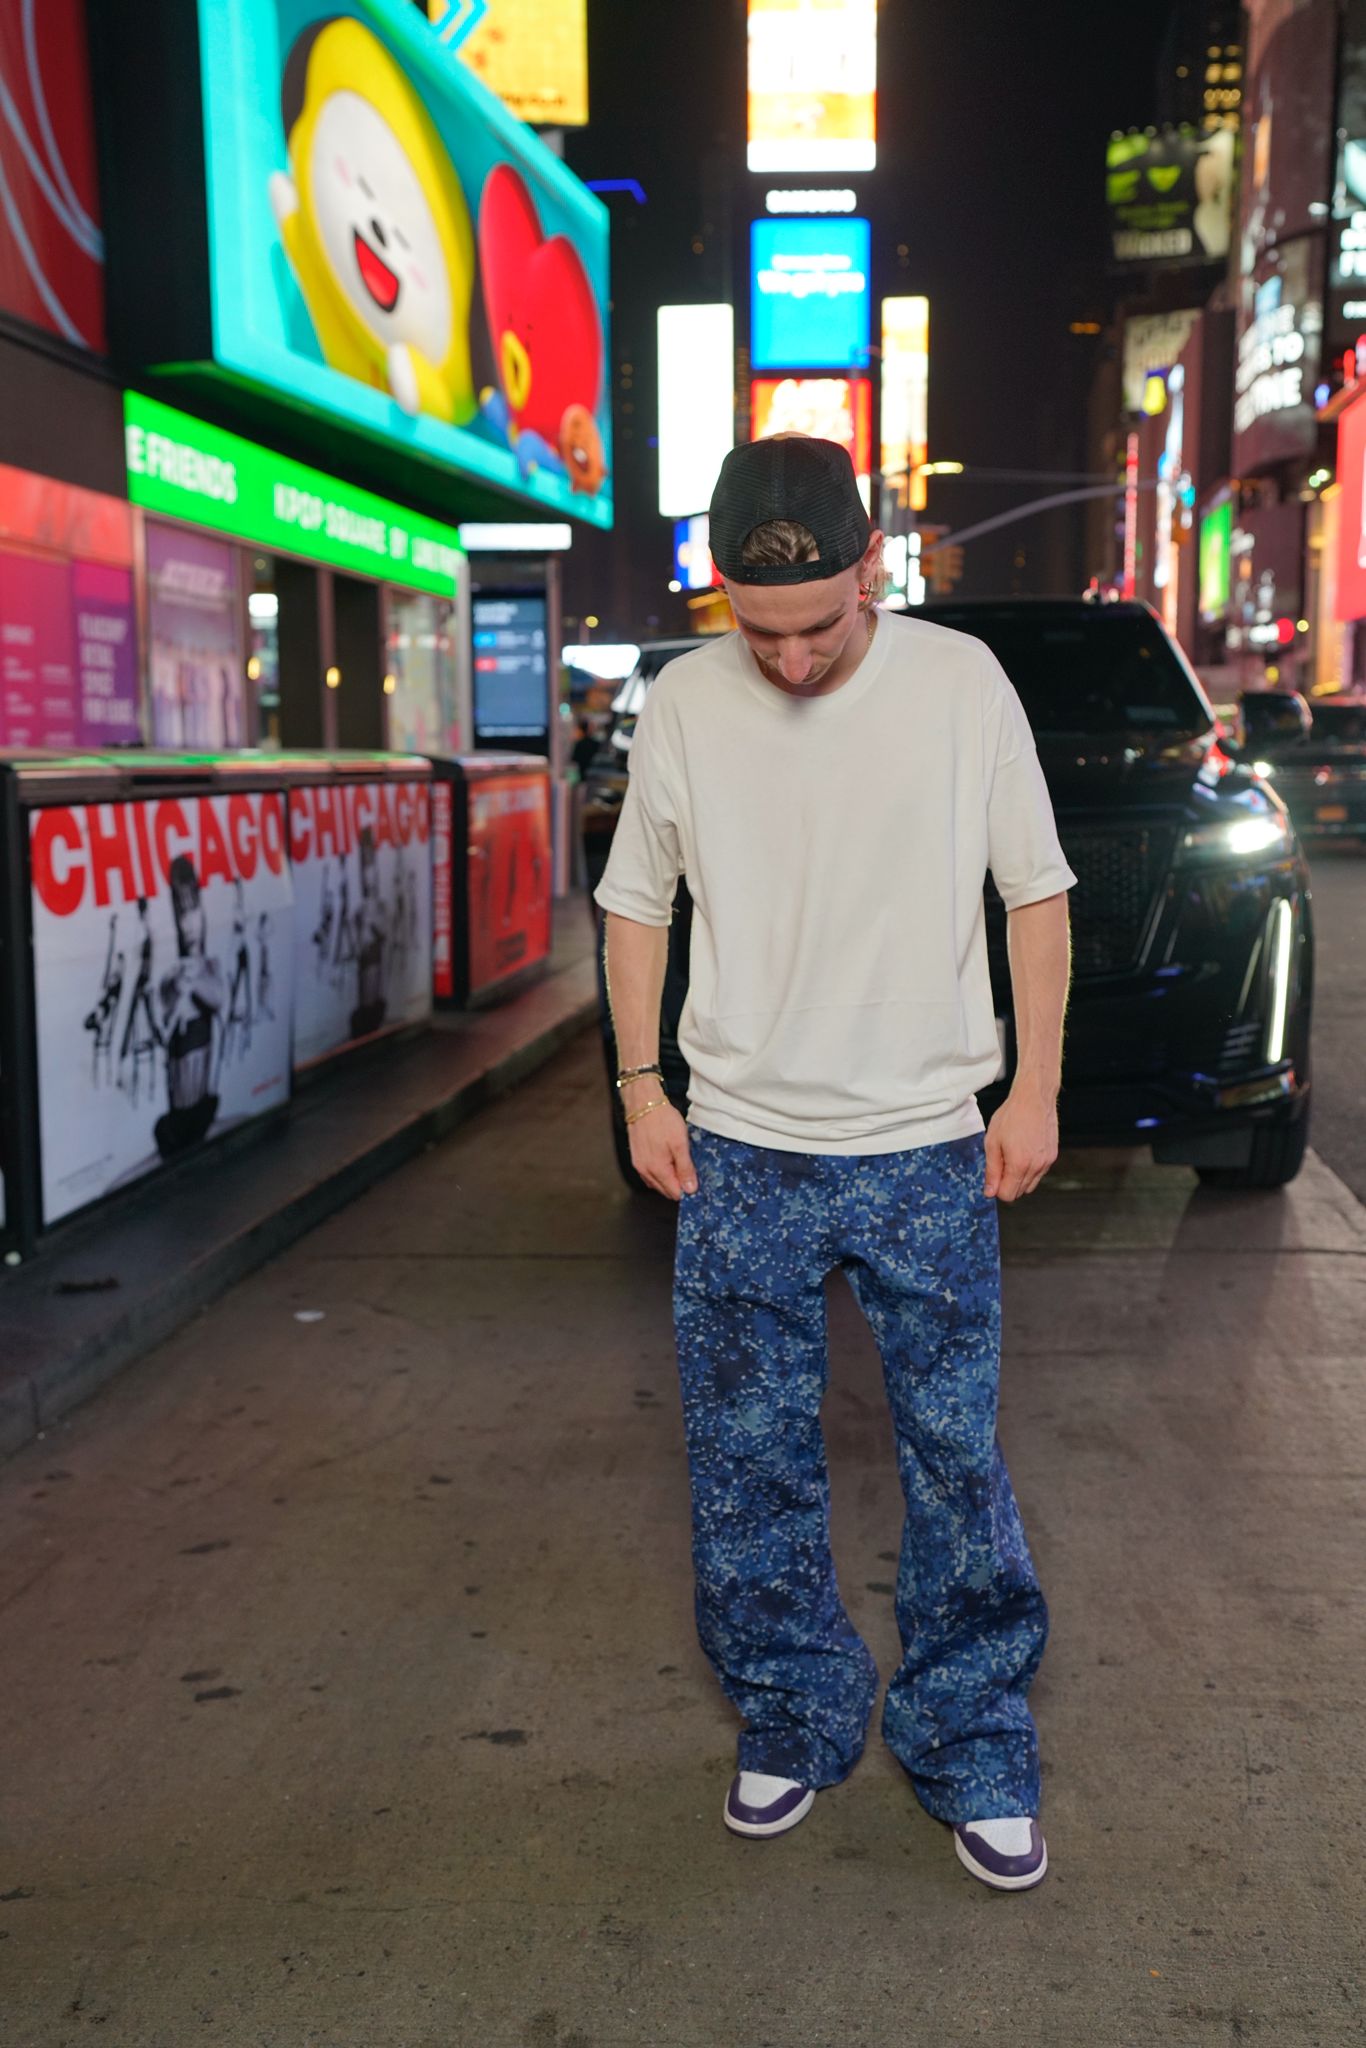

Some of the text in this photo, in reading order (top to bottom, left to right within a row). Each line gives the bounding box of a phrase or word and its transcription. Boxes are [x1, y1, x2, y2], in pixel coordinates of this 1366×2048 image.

[146, 432, 238, 504] FRIENDS
[30, 792, 284, 917] CHICAGO
[288, 780, 430, 864] CHICAGO
